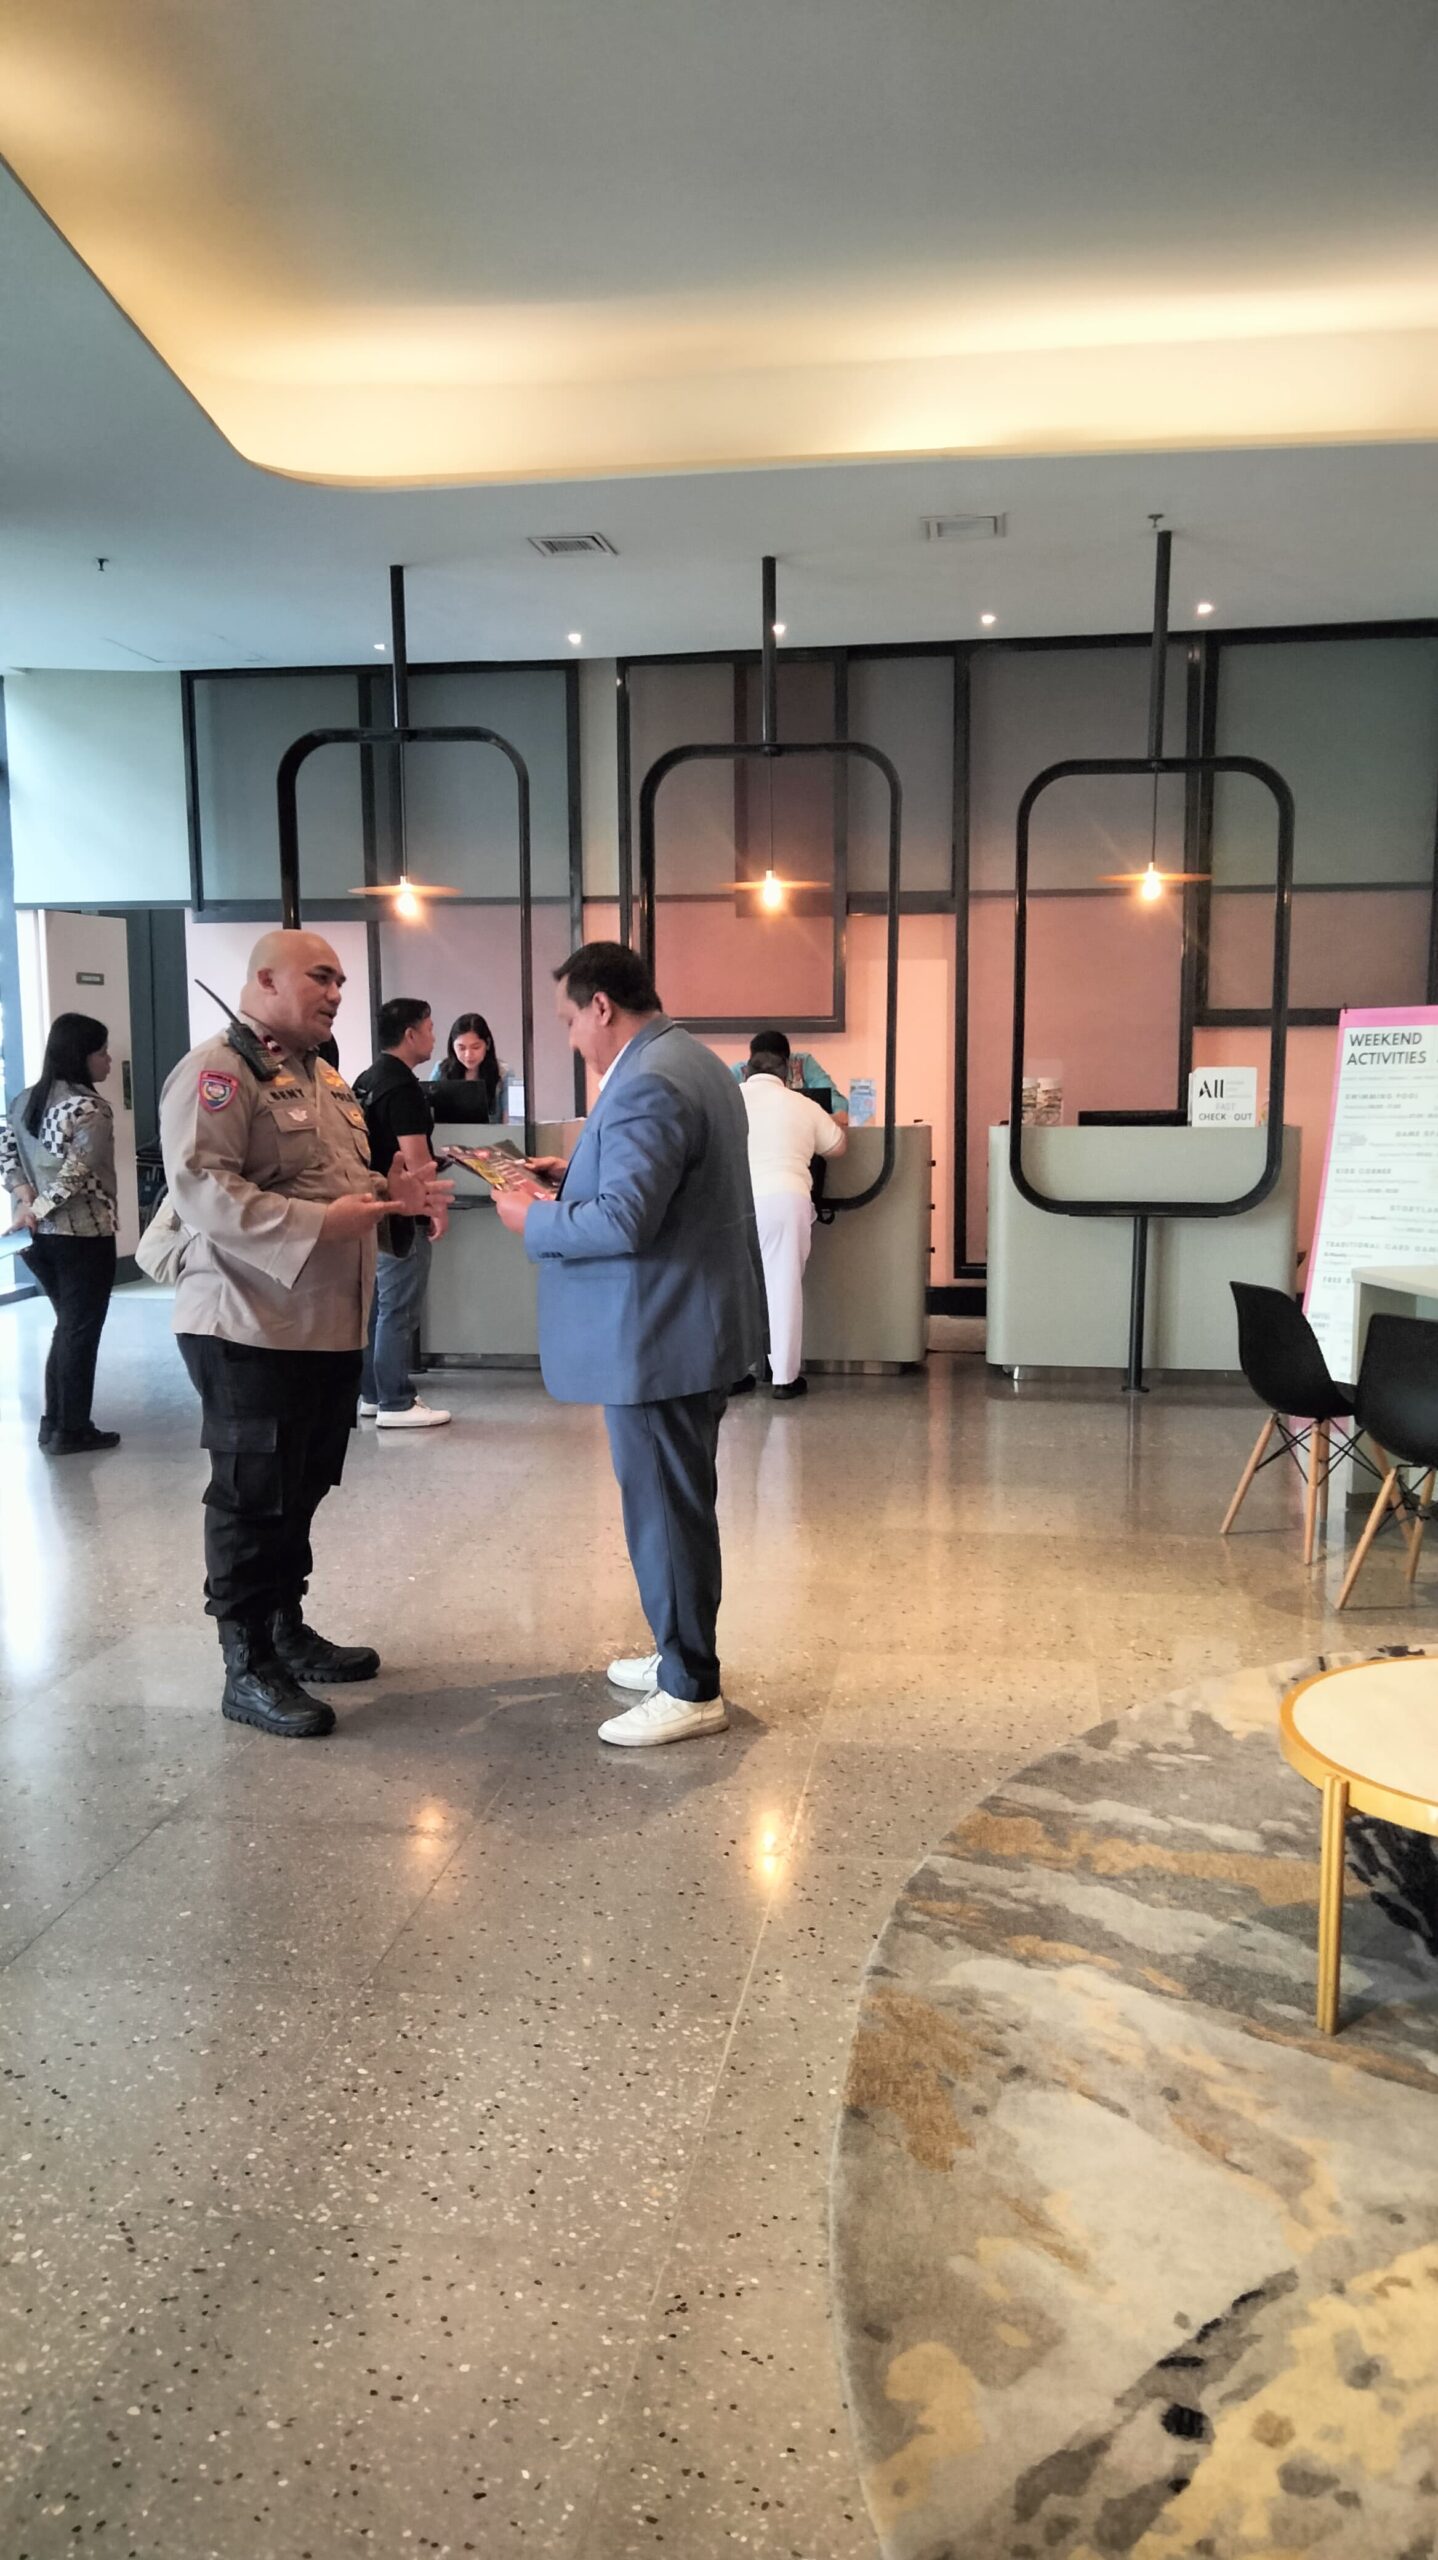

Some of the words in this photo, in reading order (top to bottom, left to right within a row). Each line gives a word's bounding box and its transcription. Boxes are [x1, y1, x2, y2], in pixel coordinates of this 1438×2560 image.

[1349, 1032, 1423, 1047] WEEKEND
[1346, 1050, 1427, 1066] ACTIVITIES
[1198, 1079, 1225, 1099] All
[1198, 1112, 1227, 1121] CHECK
[1233, 1112, 1253, 1121] OUT
